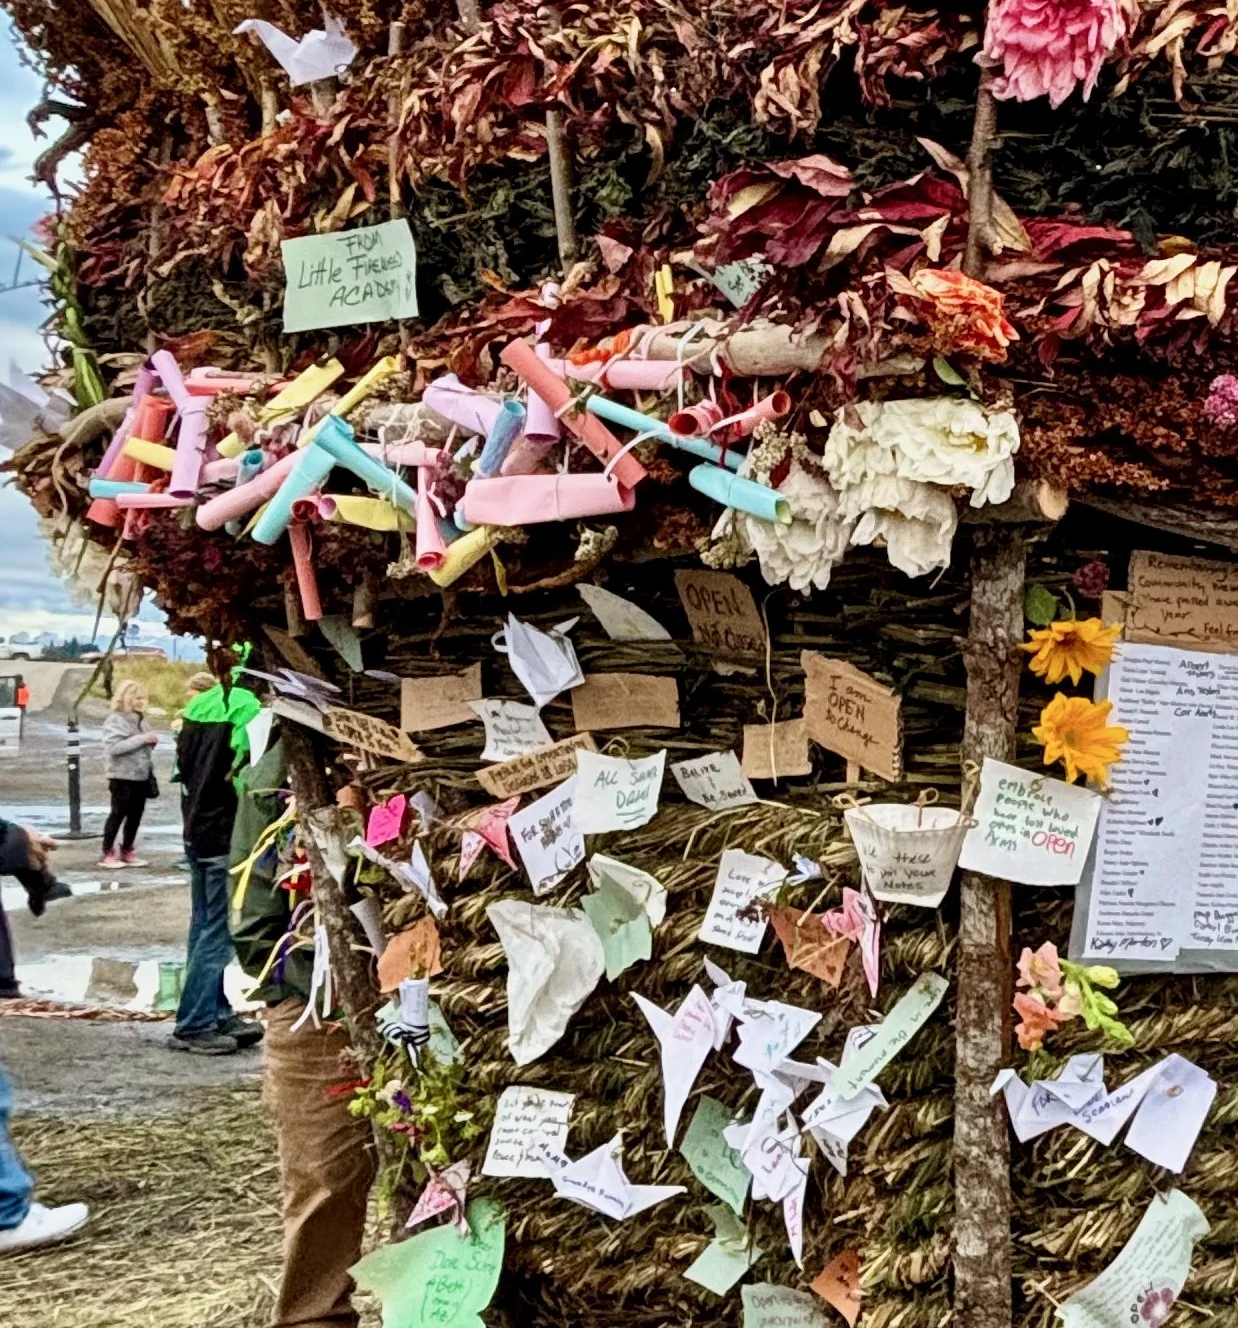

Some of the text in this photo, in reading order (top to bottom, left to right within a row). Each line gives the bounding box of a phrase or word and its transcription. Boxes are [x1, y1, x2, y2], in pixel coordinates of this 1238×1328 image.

[298, 257, 343, 289] Little
[686, 583, 743, 616] OPEN
[1203, 621, 1224, 636] Feel
[828, 692, 865, 720] OPEN
[846, 686, 871, 703] am
